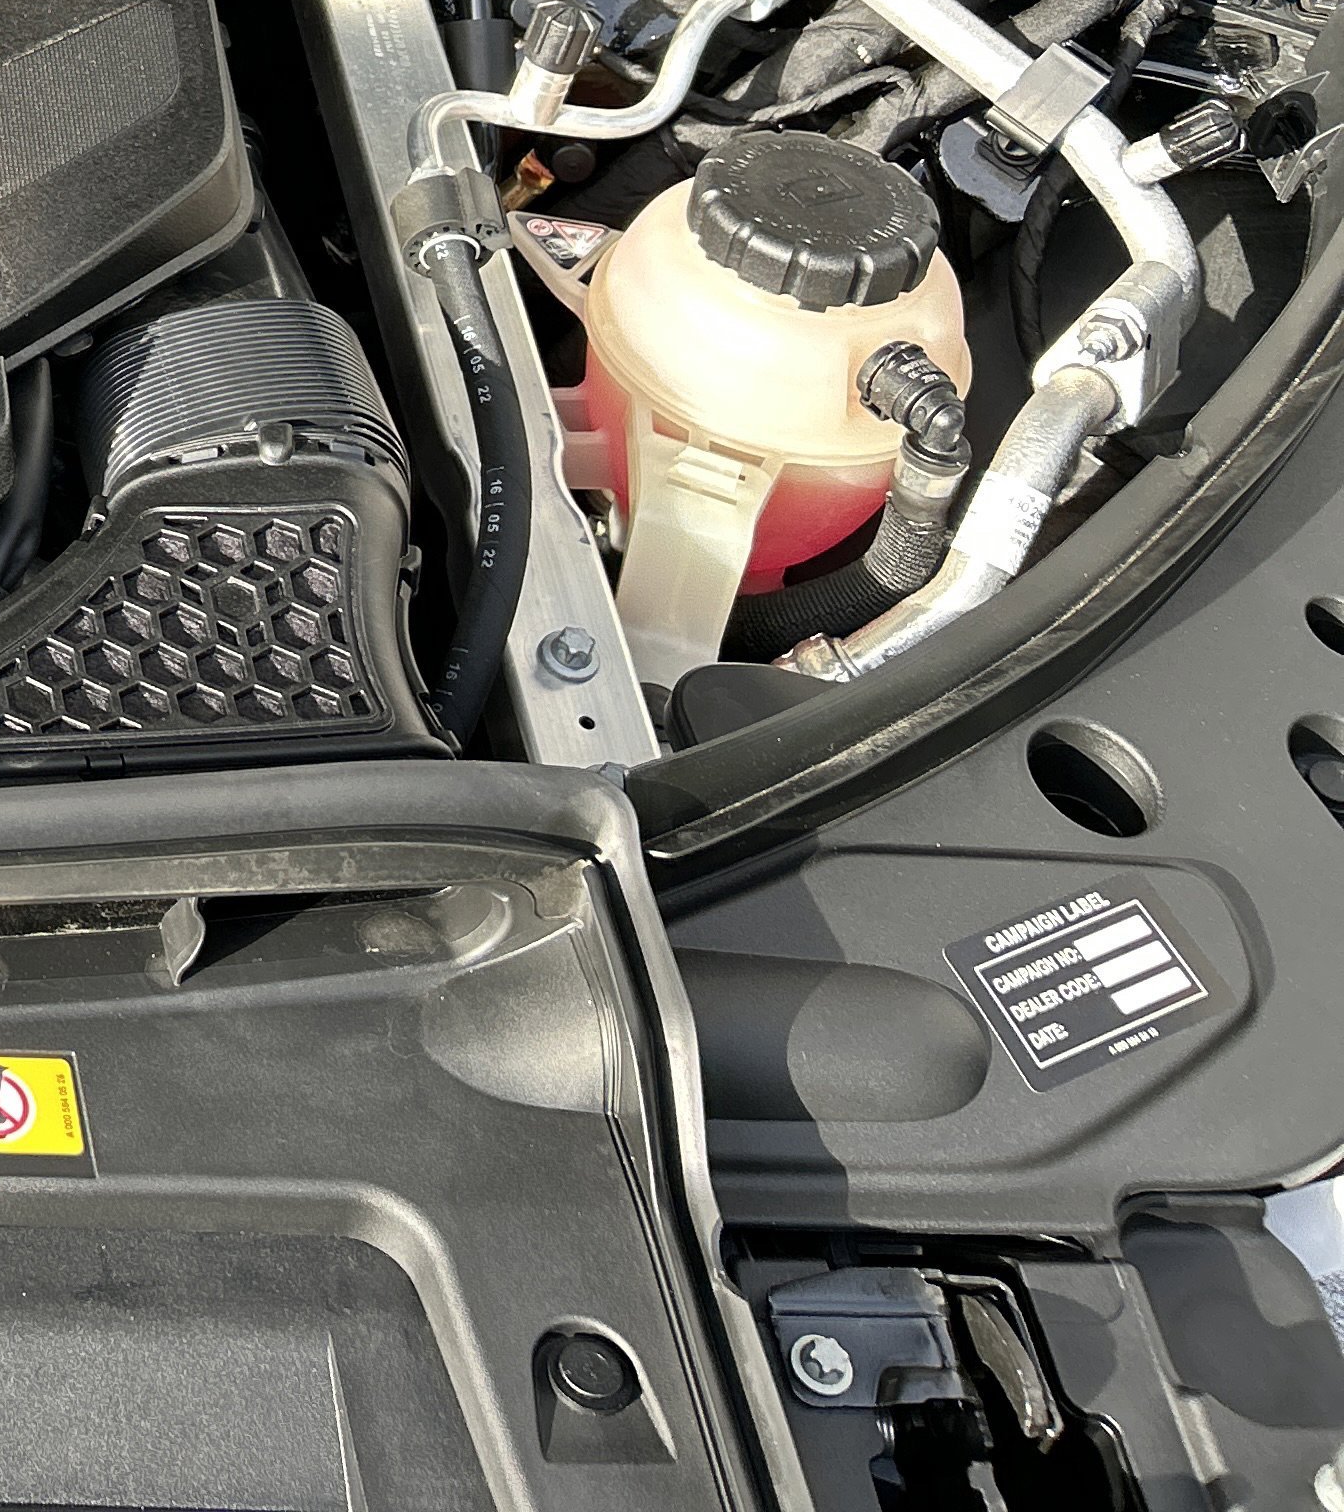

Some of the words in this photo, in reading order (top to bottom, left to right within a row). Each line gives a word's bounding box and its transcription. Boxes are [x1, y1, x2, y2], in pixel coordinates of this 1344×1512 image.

[435, 242, 449, 260] 22
[461, 326, 477, 342] 16
[469, 355, 486, 374] 05
[477, 385, 492, 404] 22
[489, 479, 503, 495] 16
[487, 514, 500, 532] 05
[480, 549, 496, 569] 22
[445, 663, 461, 680] 16
[984, 912, 1063, 953] CAMPAIGN
[1062, 892, 1111, 922] LABEL
[992, 953, 1061, 994] CAMPAIGN
[1057, 947, 1084, 967] NO:
[1009, 989, 1062, 1023] DEALER
[1058, 973, 1103, 1001] CODE:
[1027, 1022, 1069, 1051] DATE:
